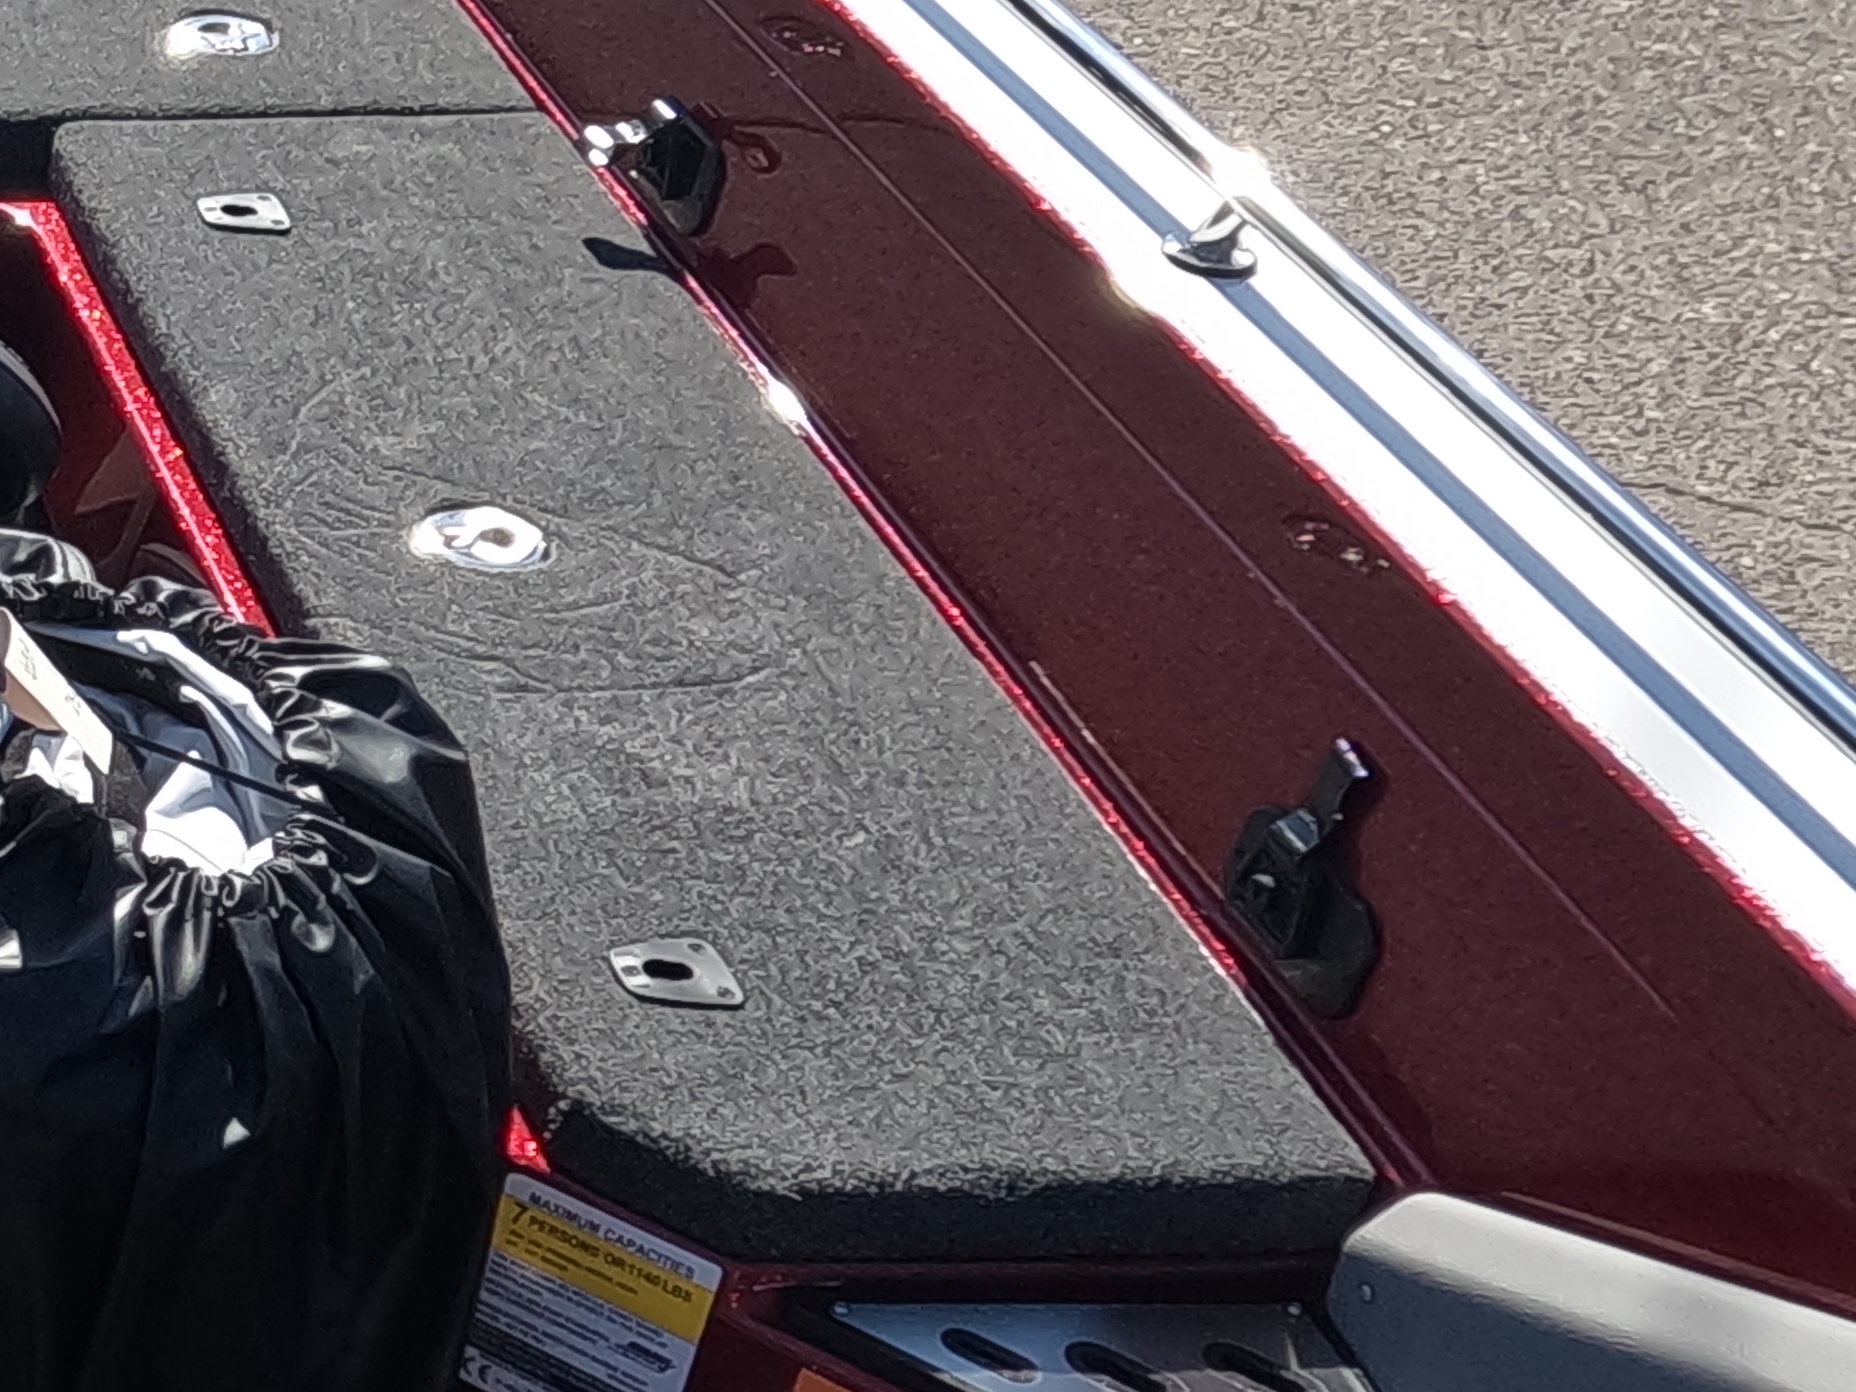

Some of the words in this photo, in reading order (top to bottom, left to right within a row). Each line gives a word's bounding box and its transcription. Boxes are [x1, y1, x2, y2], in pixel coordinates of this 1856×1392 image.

[511, 1200, 529, 1226] 7
[528, 1214, 600, 1258] PERSONS
[529, 1191, 601, 1236] MAXIMUM
[604, 1226, 696, 1280] CAPACITIES
